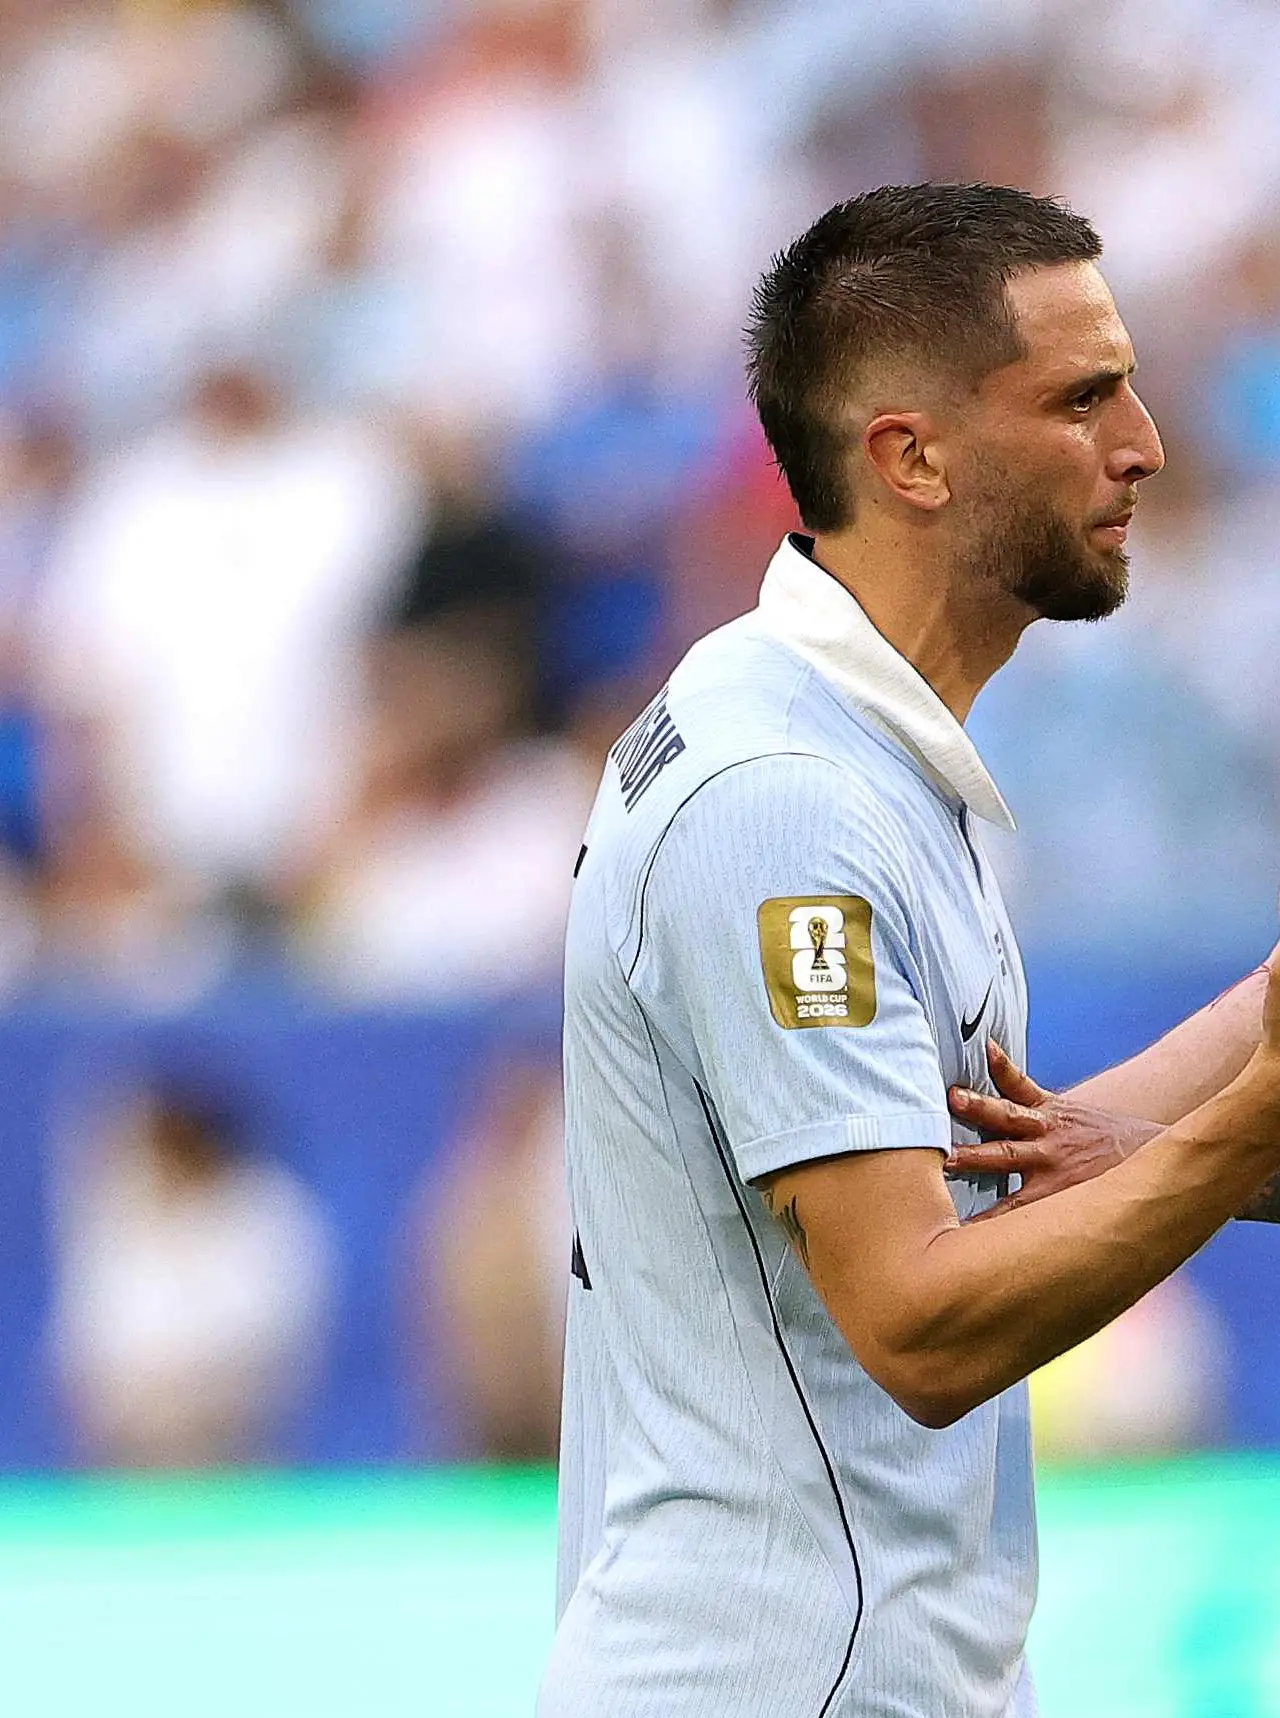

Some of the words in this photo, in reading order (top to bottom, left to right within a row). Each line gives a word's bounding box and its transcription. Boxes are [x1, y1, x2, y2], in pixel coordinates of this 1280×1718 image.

[810, 974, 833, 983] FIFA
[795, 995, 828, 1004] WORLD
[829, 994, 848, 1003] CUP
[797, 1003, 849, 1018] 2026
